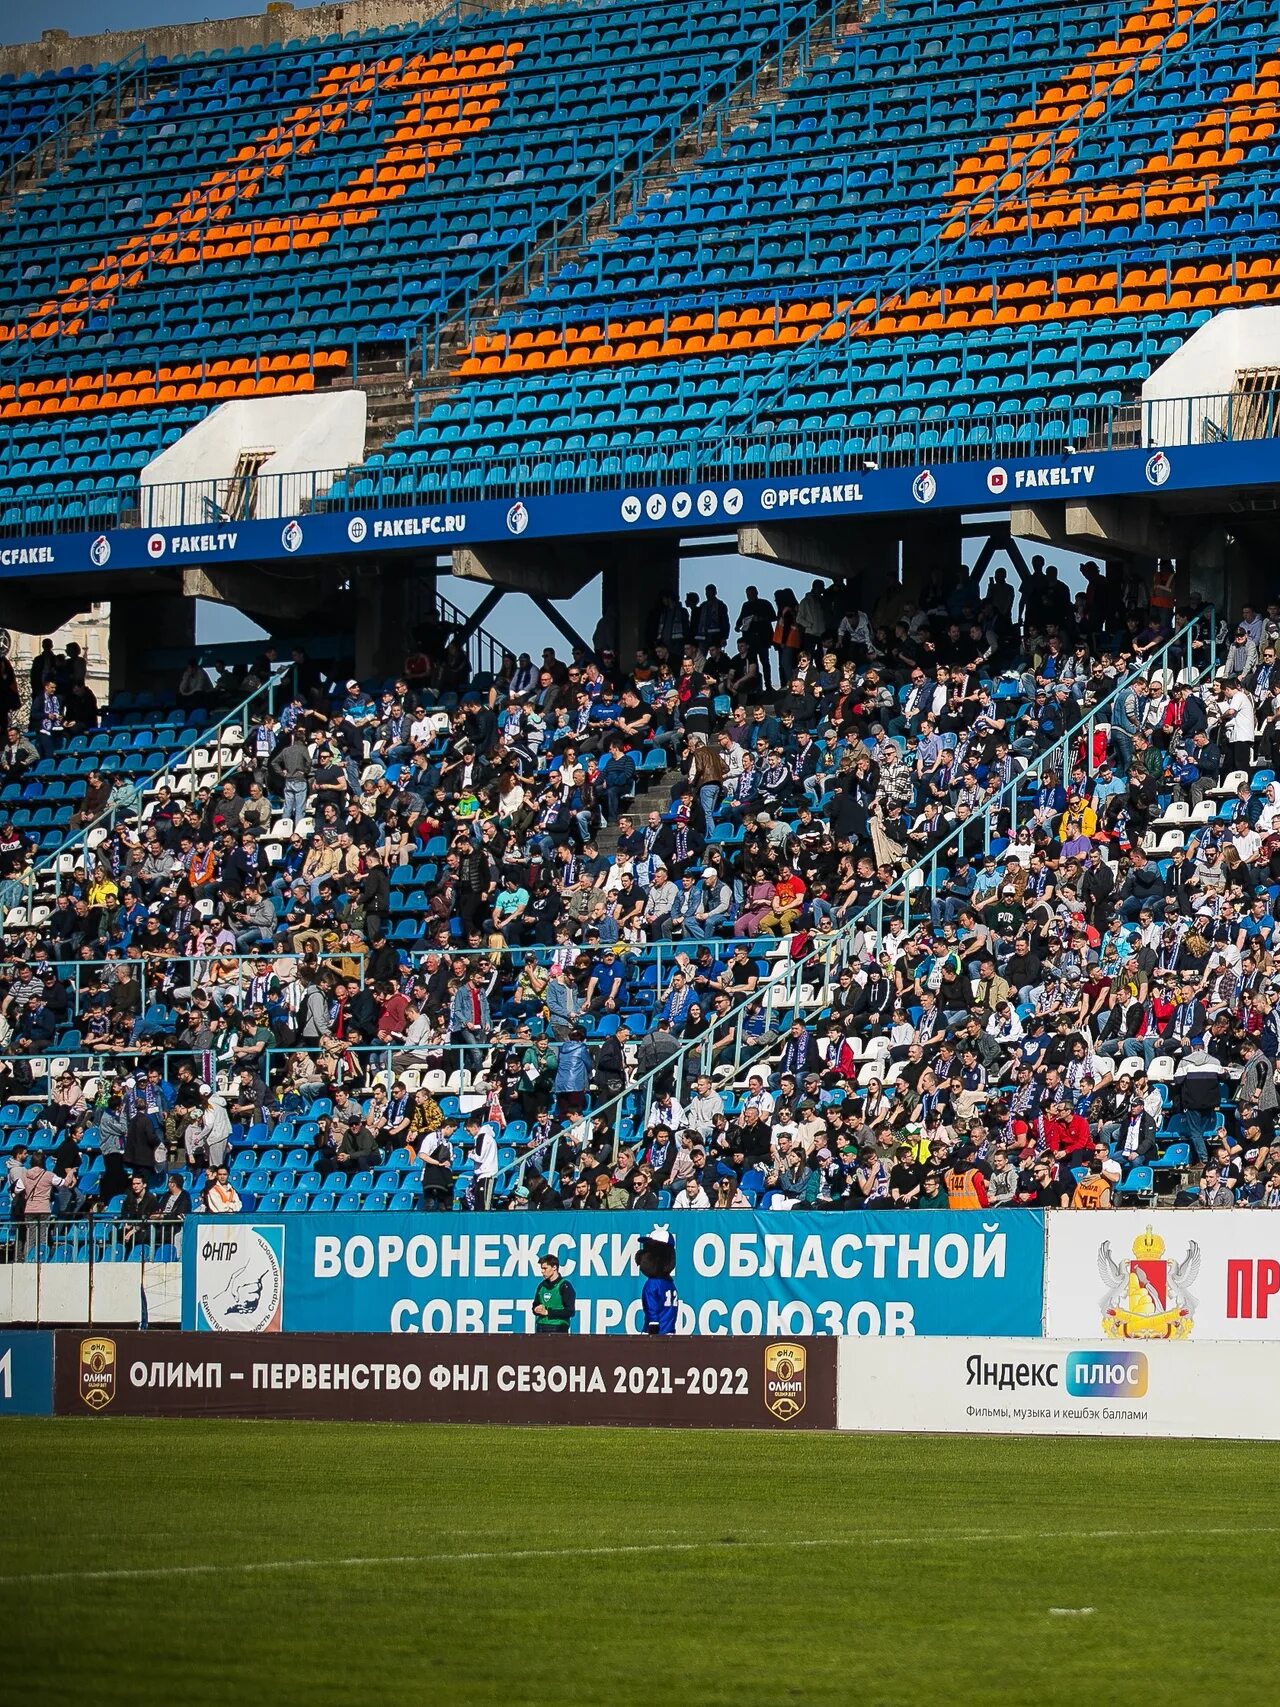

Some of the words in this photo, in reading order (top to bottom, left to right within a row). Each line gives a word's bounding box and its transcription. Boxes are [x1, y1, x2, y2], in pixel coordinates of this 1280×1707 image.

[1015, 465, 1095, 488] FAKELTV
[761, 484, 863, 510] @PFCFAKEL
[373, 514, 466, 538] FAKELFC.RU
[171, 533, 238, 553] FAKELTV
[950, 1176, 964, 1191] 144
[202, 1241, 238, 1261] ФНПР
[693, 1223, 1007, 1278] ОБЛАСТНОЙ
[83, 1373, 112, 1383] ОЛИМП
[129, 1361, 222, 1388] ОЛИМП
[252, 1363, 422, 1391] ПЕРВЕНСТВО
[428, 1364, 489, 1391] ФНЛ
[502, 1364, 607, 1393] СЕЗОНА
[613, 1365, 749, 1395] 2021-2022
[966, 1354, 1059, 1391] Яндекс
[768, 1381, 802, 1392] ОЛИМП
[966, 1405, 1011, 1418] Фильмы,
[1013, 1408, 1051, 1420] музыка
[1053, 1409, 1060, 1418] и
[1062, 1407, 1100, 1419] кешбэк
[1102, 1407, 1148, 1420] баллами
